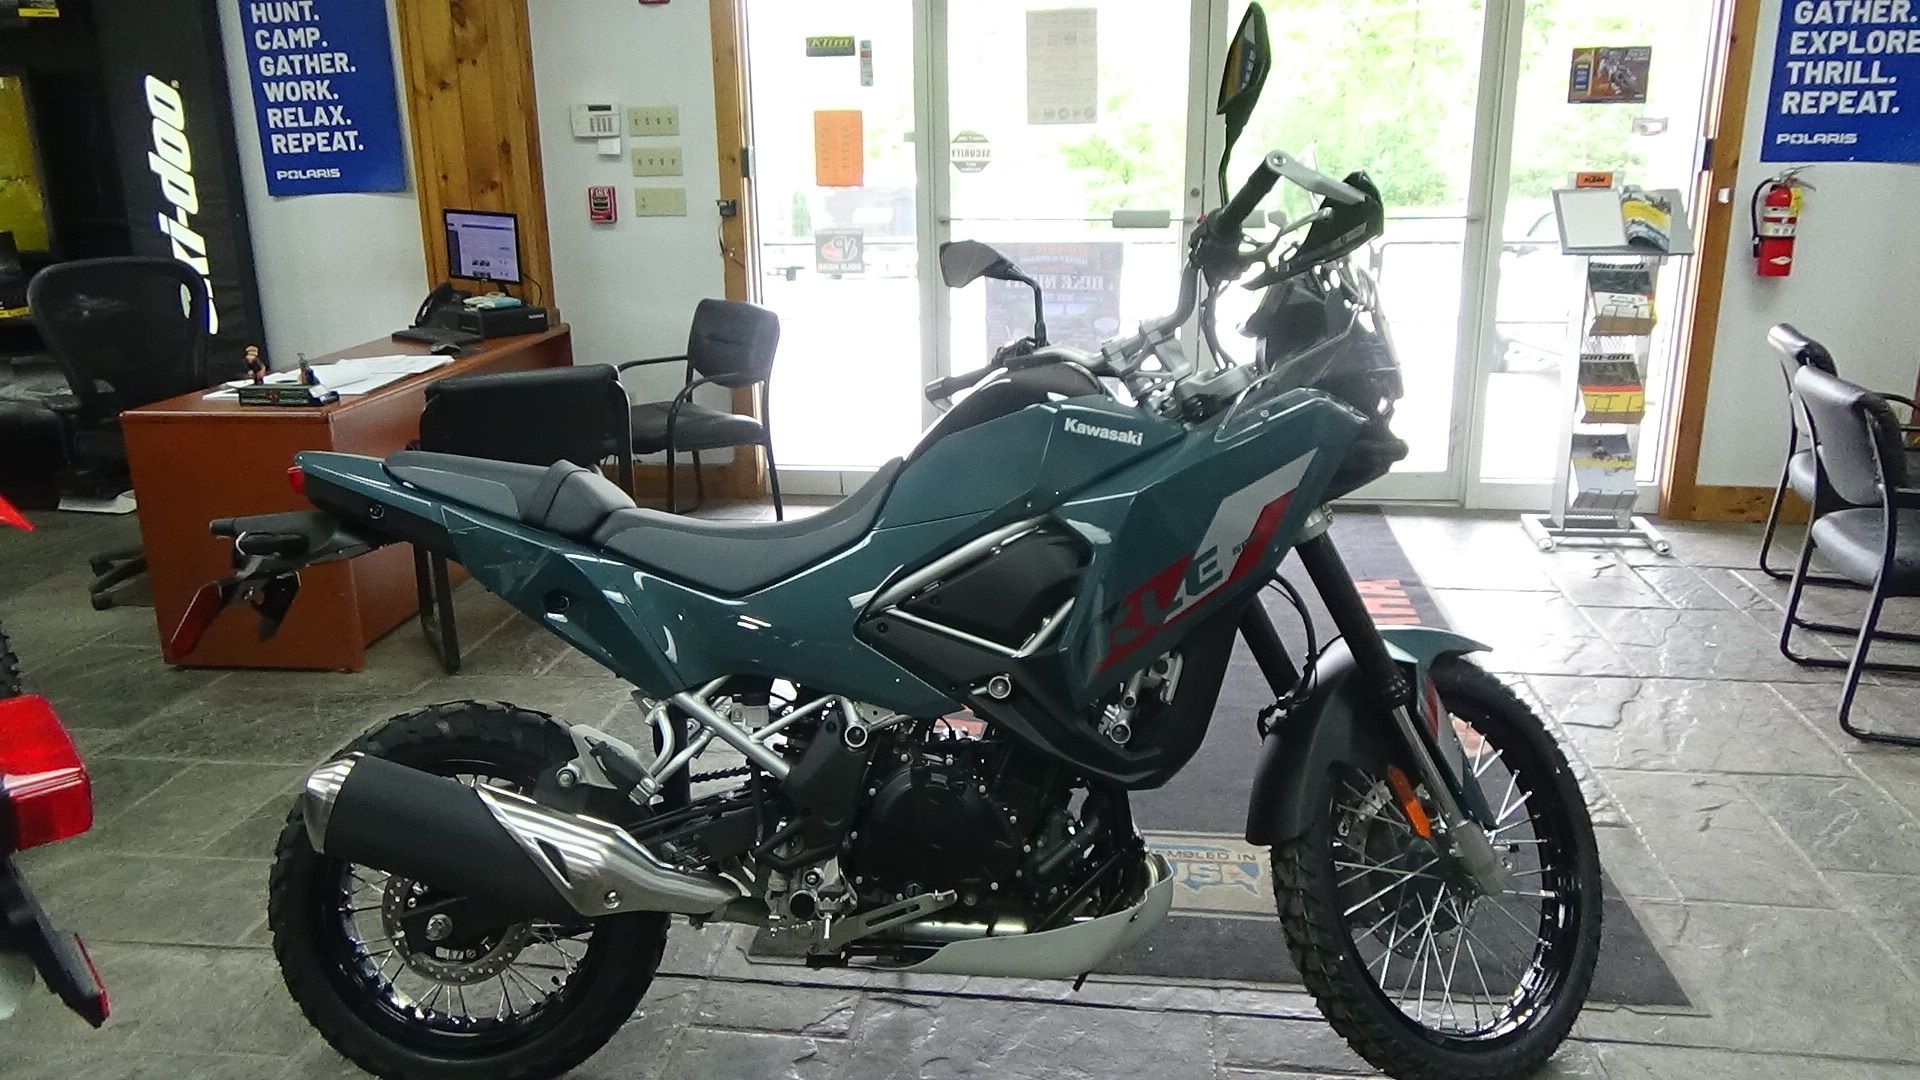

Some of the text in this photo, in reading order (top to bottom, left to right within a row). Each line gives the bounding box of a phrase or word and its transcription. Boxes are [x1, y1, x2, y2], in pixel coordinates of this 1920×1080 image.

[251, 1, 320, 23] HUNT.
[1794, 0, 1918, 24] GATHER.
[255, 27, 328, 50] CAMP.
[259, 52, 356, 76] GATHER.
[1786, 60, 1897, 85] THRILL.
[262, 79, 339, 102] WORK.
[1781, 90, 1900, 115] REPEAT.
[267, 105, 352, 128] RELAX.
[271, 131, 364, 154] REPEAT.
[1775, 132, 1858, 144] POLARIS
[276, 168, 341, 180] POLARIS
[145, 74, 219, 335] ki-doo
[1064, 417, 1144, 446] Kawasaki
